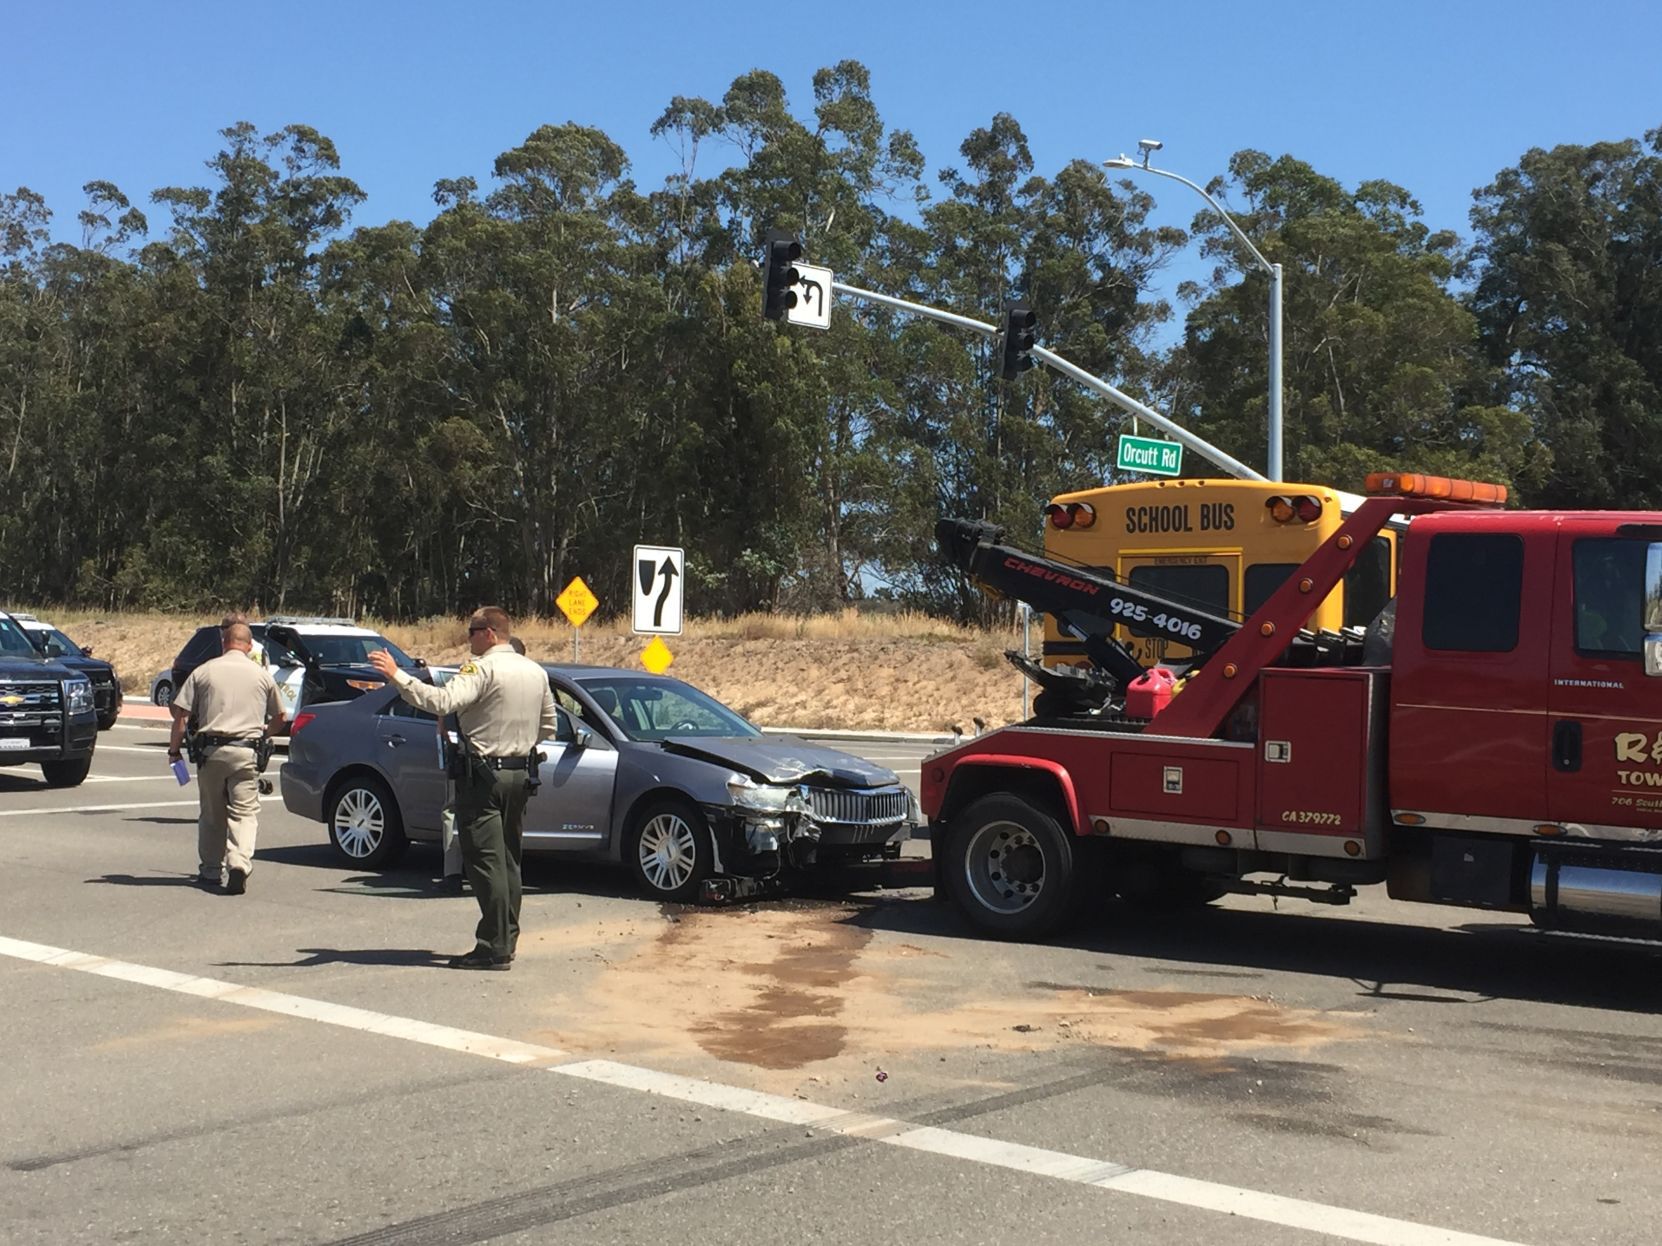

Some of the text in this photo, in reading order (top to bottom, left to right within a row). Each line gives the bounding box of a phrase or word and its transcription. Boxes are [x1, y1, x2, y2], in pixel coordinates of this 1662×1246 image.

[1123, 442, 1177, 469] Orcutt Rd
[1126, 503, 1235, 533] SCHOOL BUS
[1003, 557, 1099, 595] CHEVRON
[569, 599, 585, 607] LANE
[1109, 598, 1202, 640] 925-4016
[1145, 638, 1169, 660] STOP
[1554, 679, 1624, 689] INTERNATIONAL
[1611, 797, 1633, 807] 706
